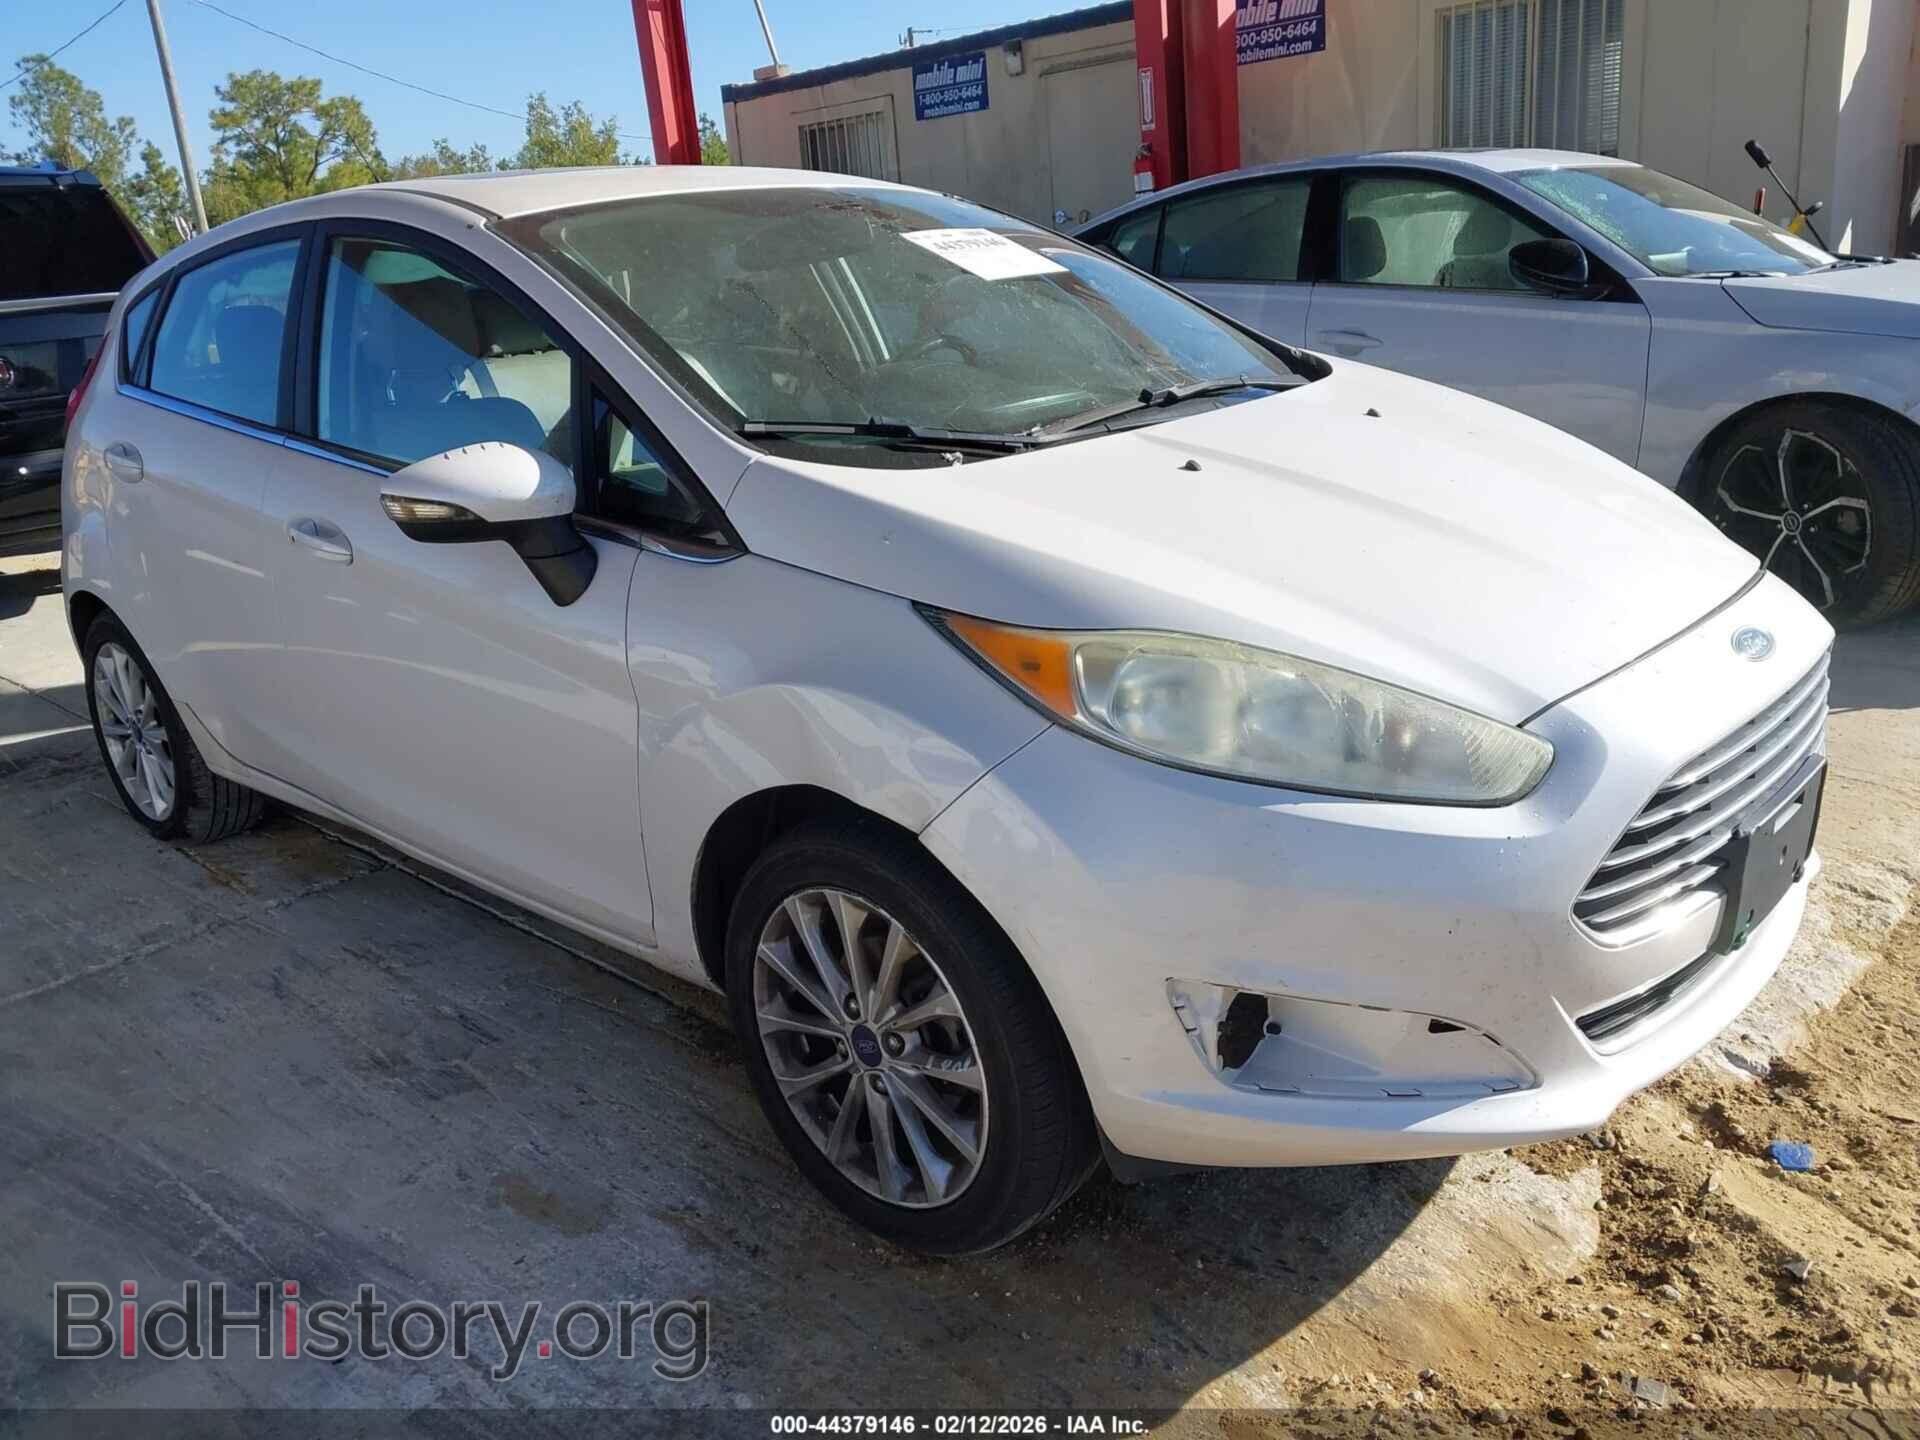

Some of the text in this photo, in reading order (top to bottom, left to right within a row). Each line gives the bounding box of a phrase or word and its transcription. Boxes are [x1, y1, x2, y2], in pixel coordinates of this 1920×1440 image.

[1236, 0, 1278, 28] obile
[915, 57, 984, 90] mobile mini
[919, 84, 983, 106] 1-800-950-6464
[923, 101, 980, 118] mobilemini.com
